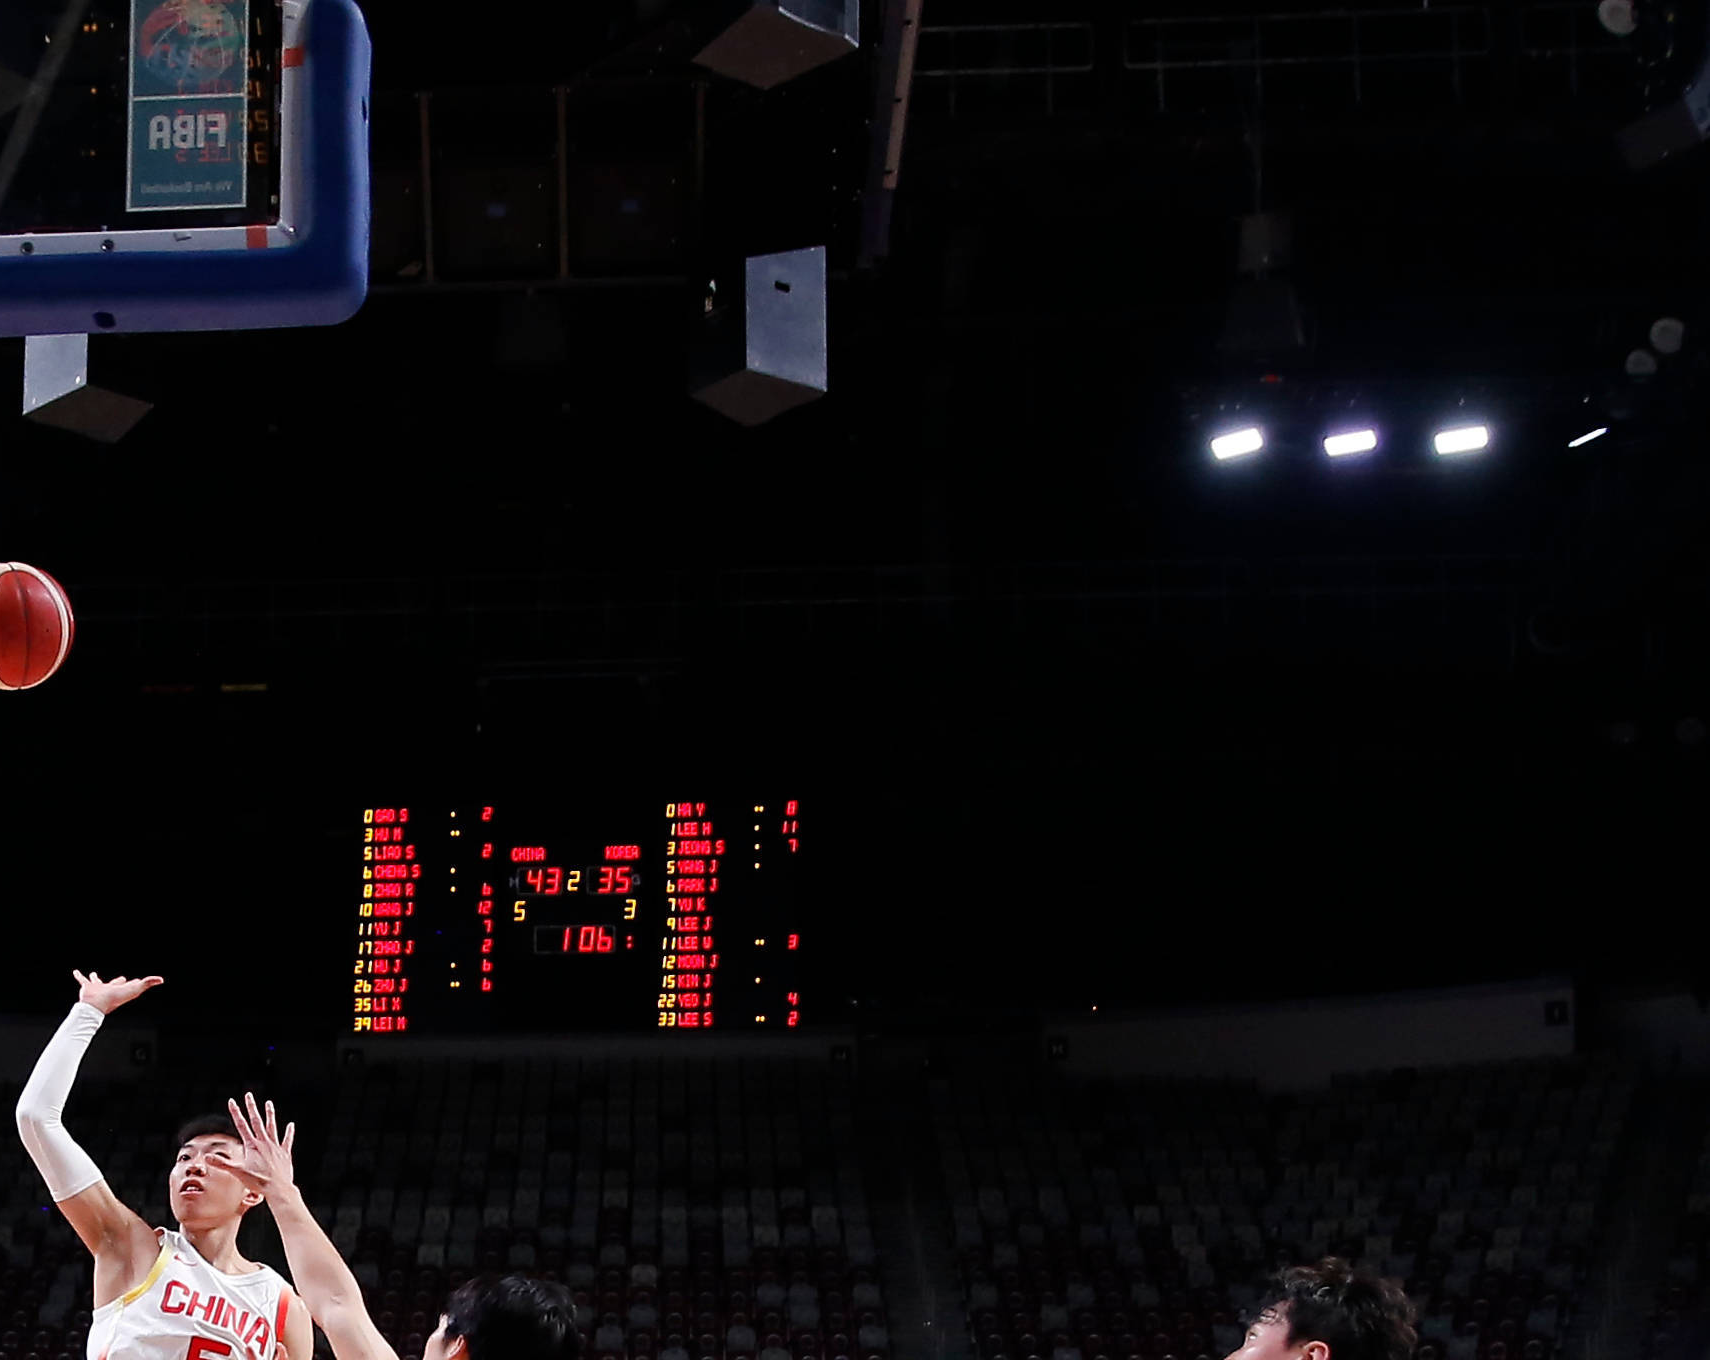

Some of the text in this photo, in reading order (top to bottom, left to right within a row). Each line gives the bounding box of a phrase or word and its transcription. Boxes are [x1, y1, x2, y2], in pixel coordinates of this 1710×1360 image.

[364, 809, 373, 824] 0
[482, 806, 493, 822] 2
[666, 804, 675, 818] 0
[786, 800, 798, 816] 8
[364, 828, 373, 842] 3
[671, 823, 675, 836] 1
[677, 822, 698, 836] LEE
[782, 820, 798, 834] 11
[364, 846, 372, 861] 5
[482, 842, 492, 859] 2
[511, 846, 641, 862] CHINA KOREA
[667, 841, 676, 855] 3
[788, 838, 798, 852] 7
[363, 866, 372, 879] 6
[667, 861, 675, 874] 5
[526, 867, 562, 894] 43
[567, 871, 581, 891] 2
[598, 866, 632, 894] 35
[666, 880, 675, 893] 6
[363, 884, 372, 898] 8
[482, 882, 493, 896] 6
[359, 903, 372, 916] 10
[478, 900, 493, 915] 12
[514, 899, 636, 921] 5 3
[668, 898, 676, 912] 7
[358, 922, 372, 936] 11
[484, 919, 493, 933] 7
[667, 917, 676, 931] 9
[678, 916, 699, 931] LEE
[358, 941, 372, 955] 17
[482, 938, 493, 953] 2
[663, 936, 676, 950] 11
[788, 934, 799, 950] 3
[354, 960, 372, 974] 21
[482, 959, 493, 972] 6
[662, 955, 676, 969] 12
[354, 979, 372, 993] 26
[482, 977, 492, 991] 6
[662, 974, 676, 988] 15
[354, 998, 372, 1012] 35
[658, 994, 676, 1008] 22
[788, 992, 798, 1006] 4
[354, 1017, 371, 1031] 39
[658, 1012, 676, 1026] 33
[678, 1012, 699, 1026] LEE
[788, 1011, 799, 1026] 2
[159, 1279, 270, 1356] CHINA
